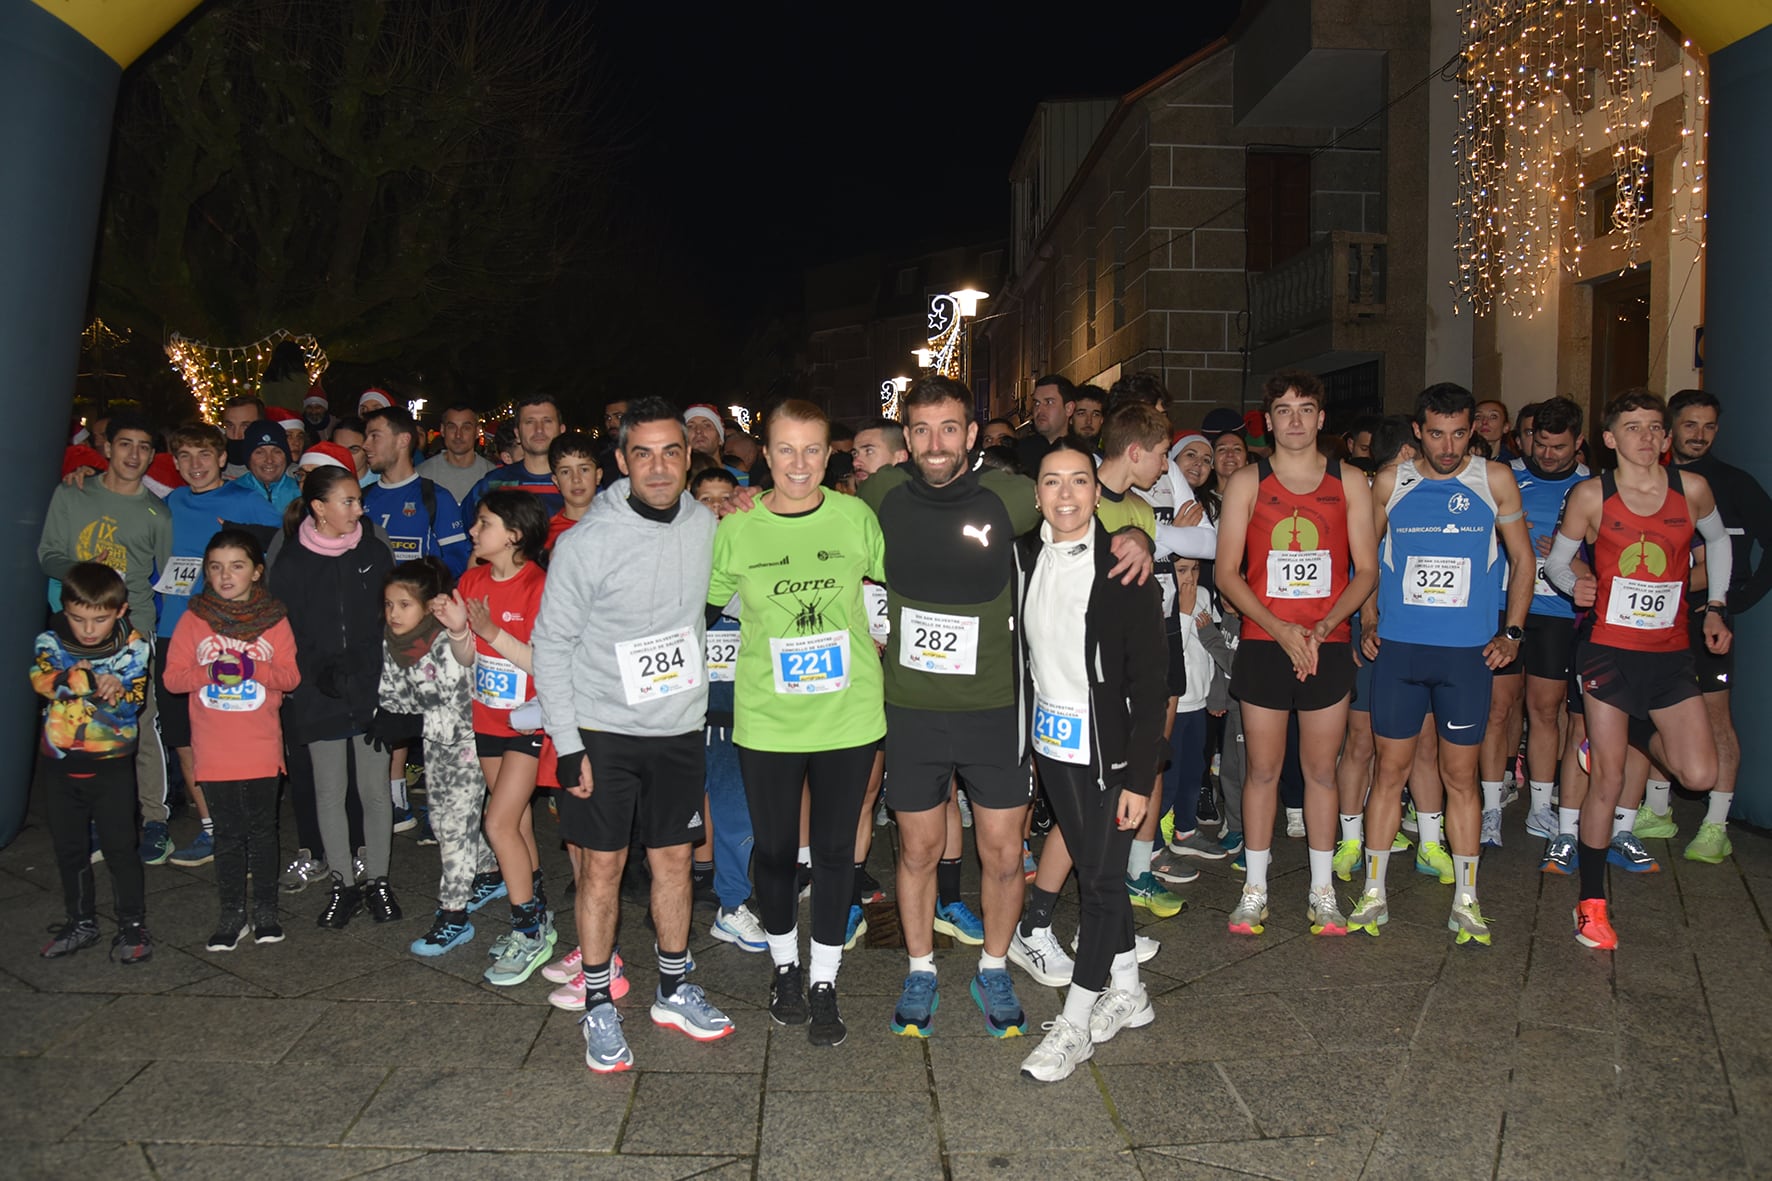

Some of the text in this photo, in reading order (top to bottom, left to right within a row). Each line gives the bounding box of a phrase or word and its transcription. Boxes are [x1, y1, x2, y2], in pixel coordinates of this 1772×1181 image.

[173, 566, 196, 582] 144
[1282, 563, 1318, 581] 192
[1416, 569, 1454, 588] 322
[773, 578, 836, 596] Corre
[1627, 592, 1666, 612] 196
[914, 628, 958, 652] 282
[638, 647, 685, 678] 284
[788, 650, 833, 676] 221
[478, 669, 509, 693] 263
[1036, 711, 1072, 741] 219
